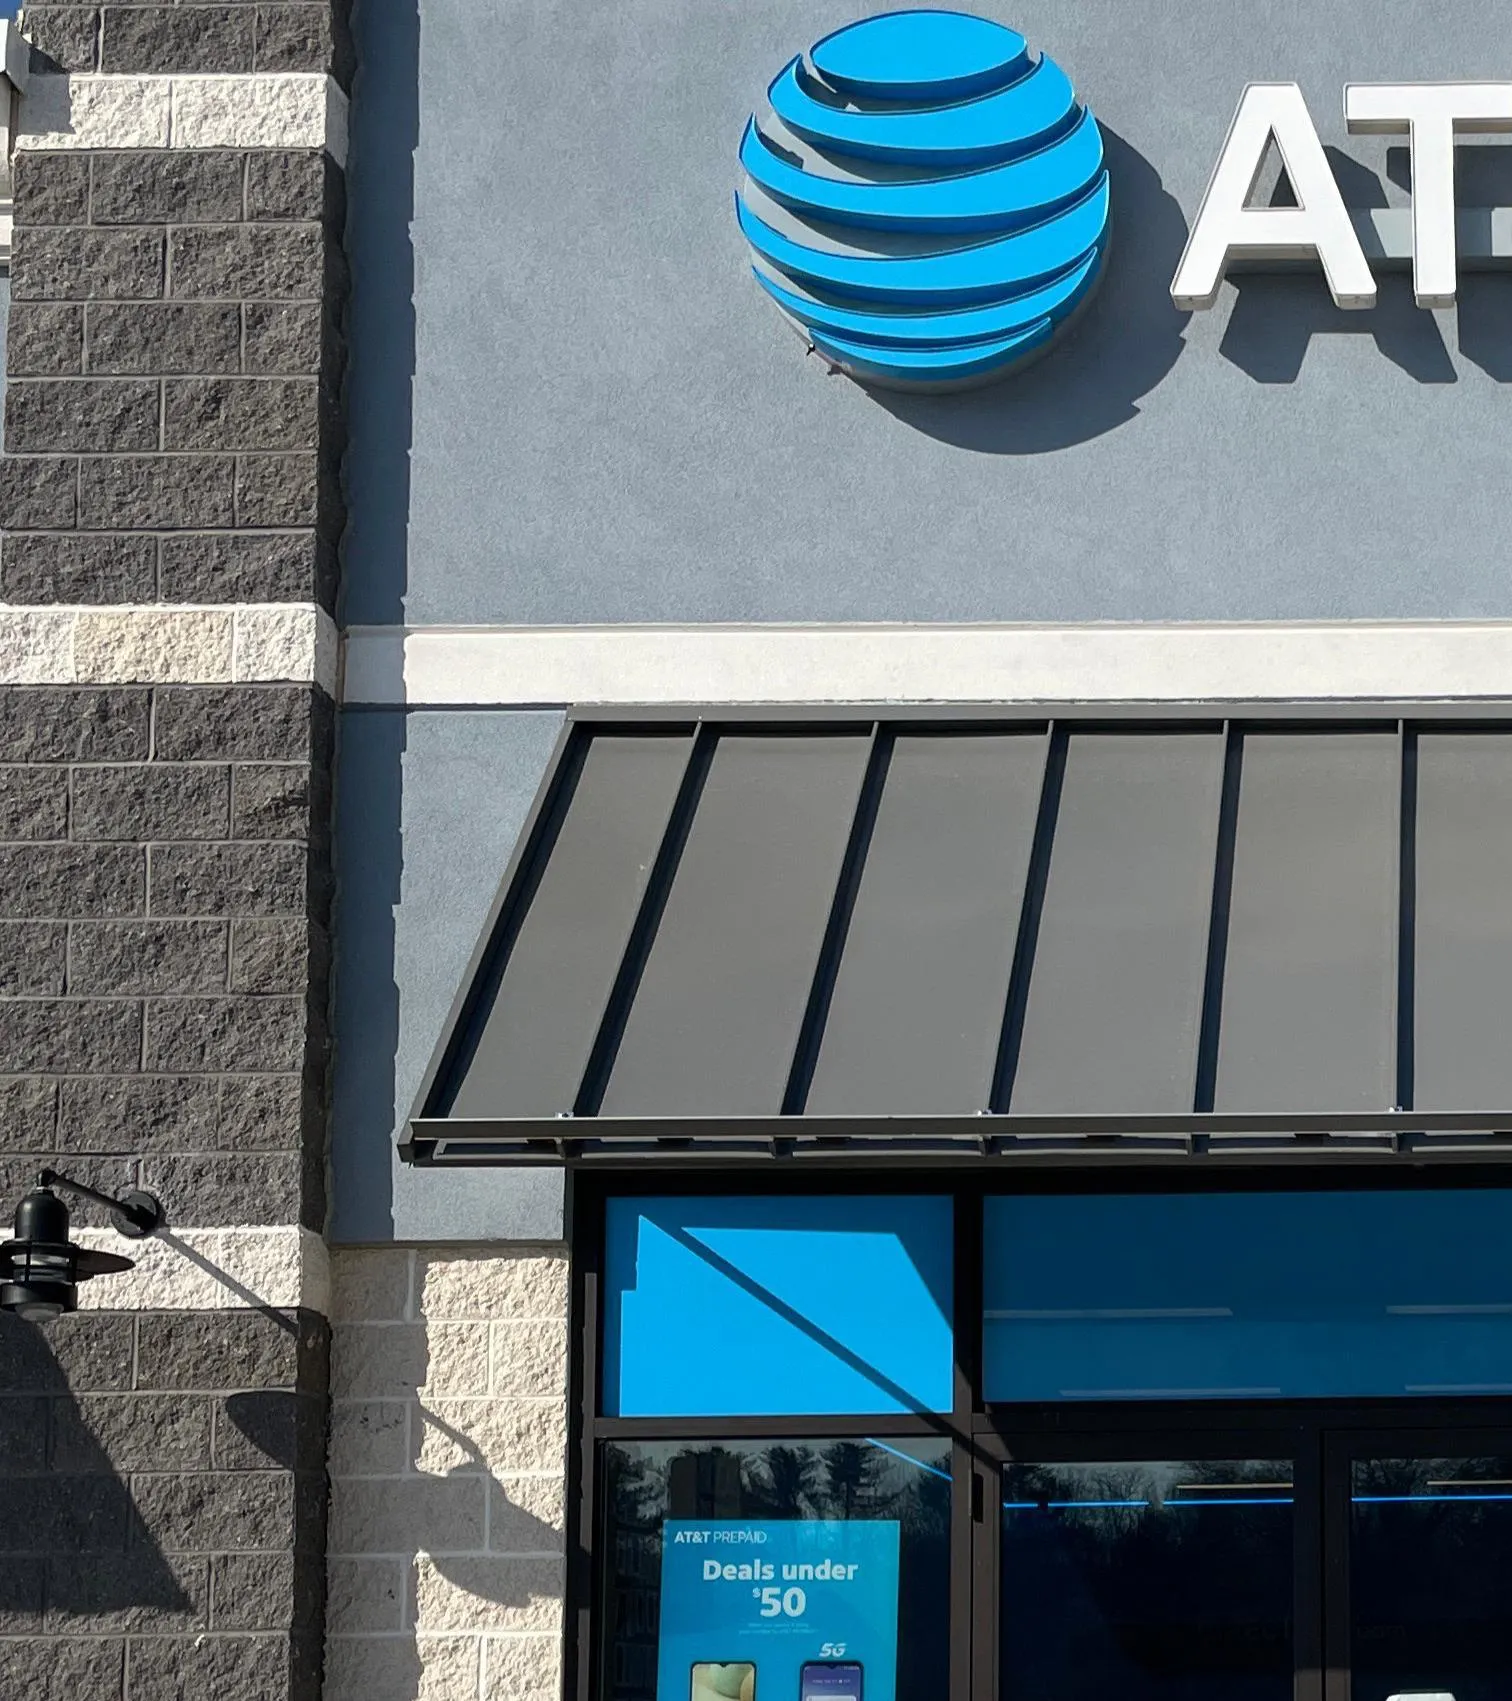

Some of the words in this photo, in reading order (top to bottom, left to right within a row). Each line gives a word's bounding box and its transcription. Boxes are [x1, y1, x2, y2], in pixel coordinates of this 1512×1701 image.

[674, 1531, 711, 1545] AT&T
[713, 1531, 767, 1545] PREPAID
[703, 1559, 775, 1581] Deals
[782, 1559, 859, 1581] under
[752, 1587, 807, 1617] $50
[819, 1643, 847, 1658] 5G
